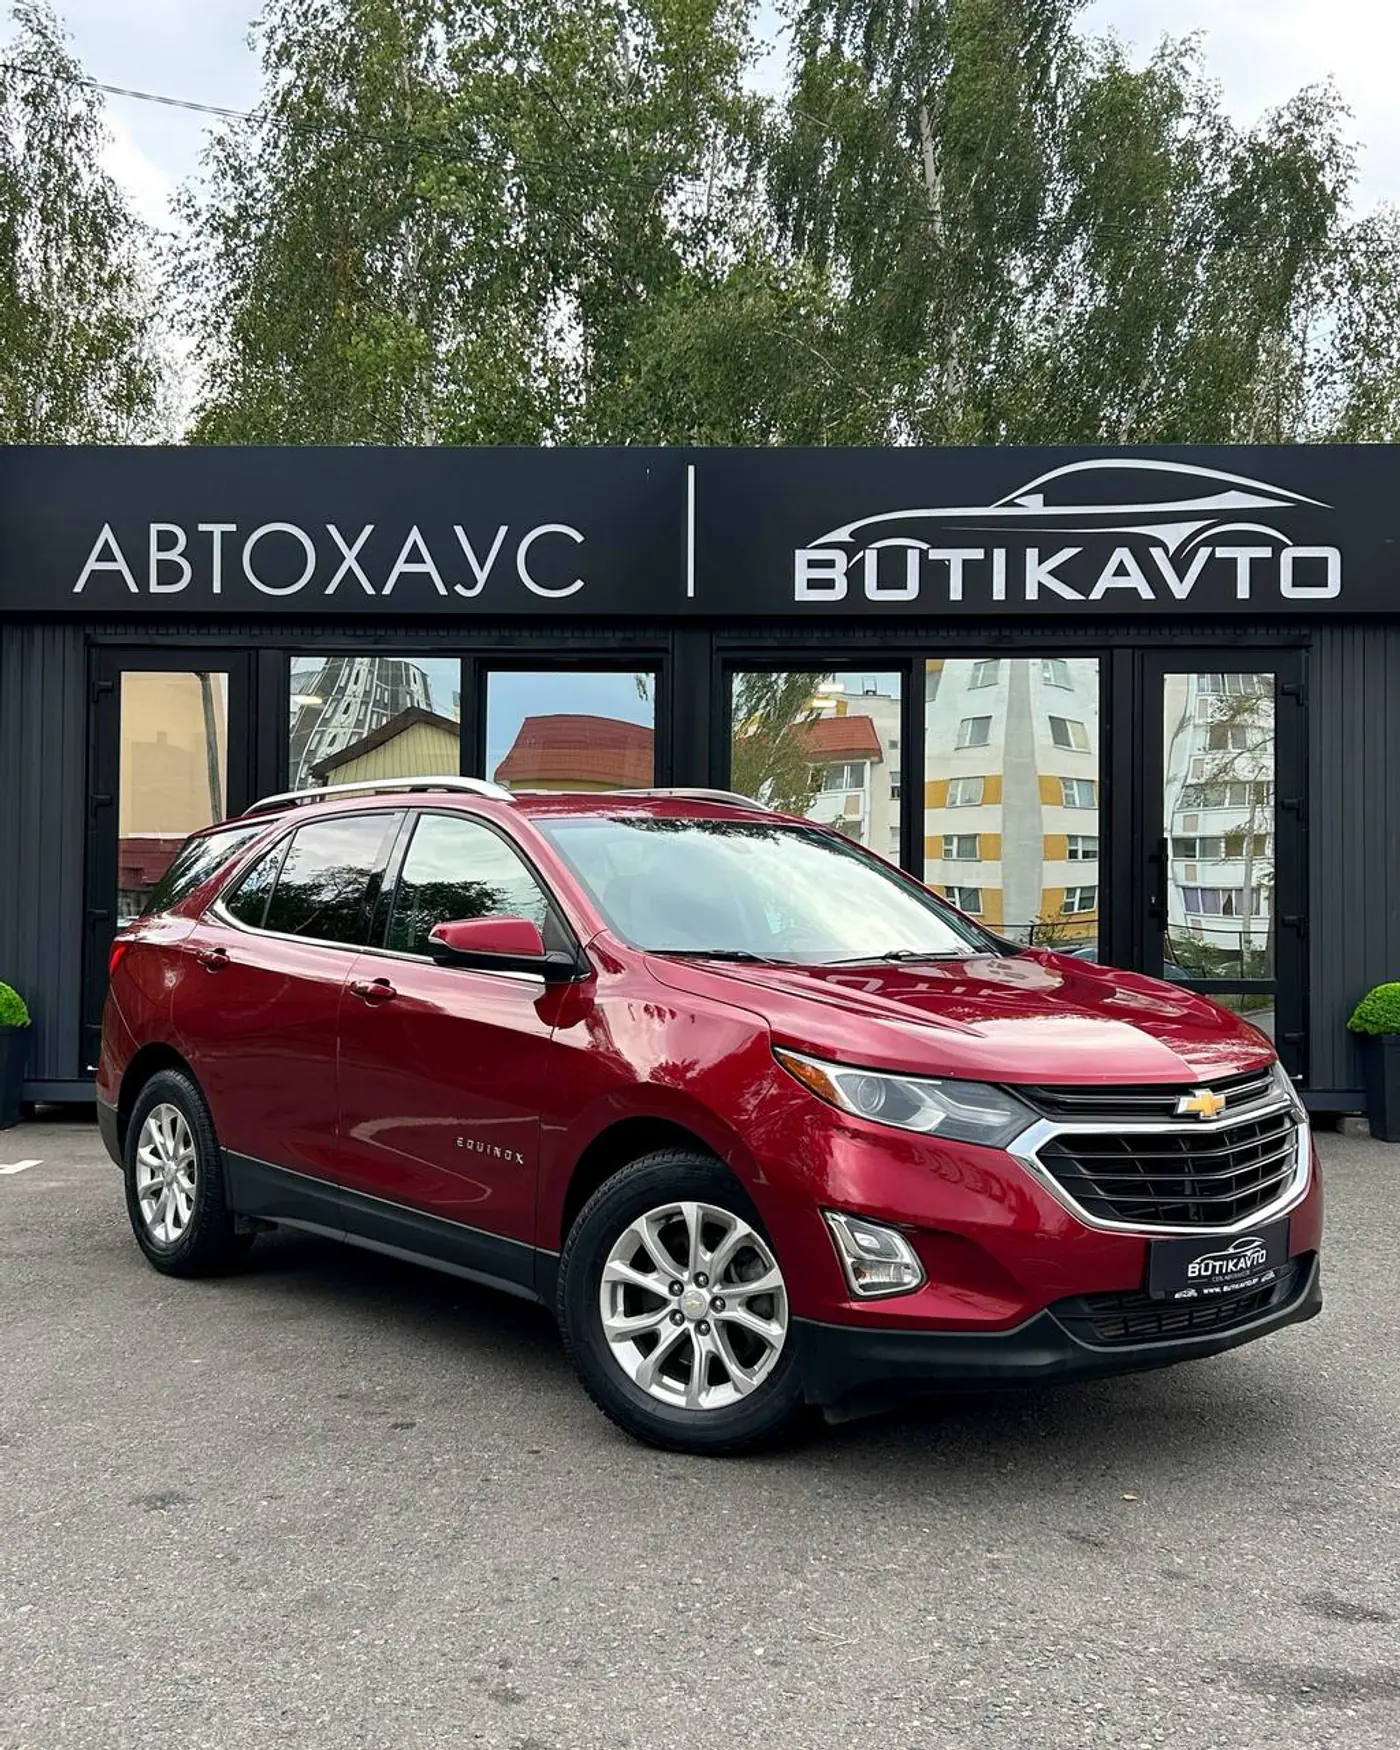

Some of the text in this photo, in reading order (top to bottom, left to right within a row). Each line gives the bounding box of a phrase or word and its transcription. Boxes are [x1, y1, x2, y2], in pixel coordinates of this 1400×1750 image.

[72, 522, 586, 598] АВТОХАУС
[794, 545, 1341, 602] BUTIKAVTO
[456, 1136, 524, 1165] EQUINOX
[1187, 1248, 1267, 1277] BUTIKAVTO
